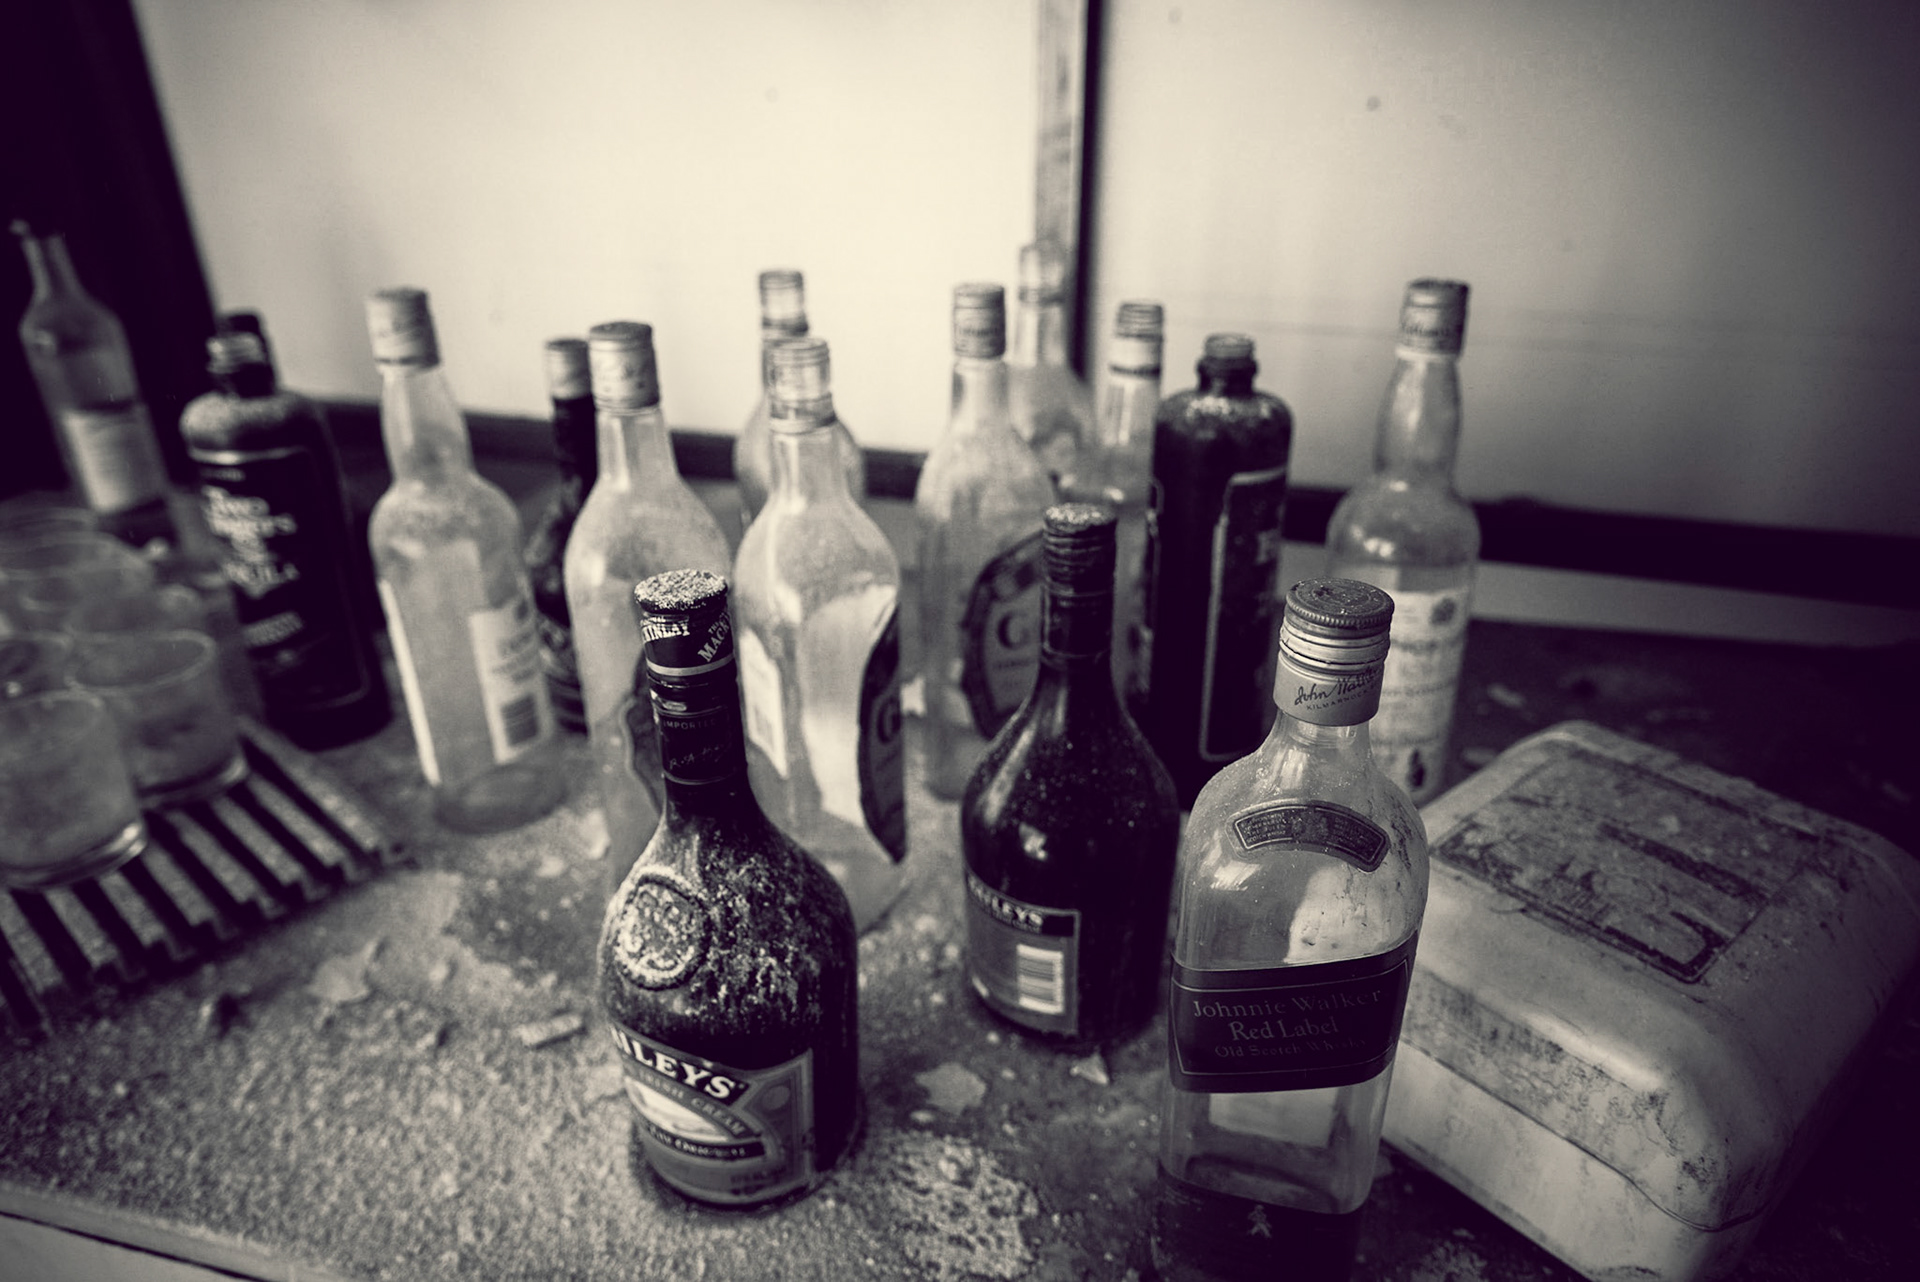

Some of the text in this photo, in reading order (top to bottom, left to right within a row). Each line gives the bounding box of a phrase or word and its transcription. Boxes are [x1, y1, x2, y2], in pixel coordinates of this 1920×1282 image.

[1294, 683, 1335, 706] John
[1193, 989, 1382, 1018] Johnnie Walker
[1228, 1015, 1339, 1042] Red Label
[1215, 1044, 1244, 1058] Old
[1249, 1041, 1301, 1057] Scotch
